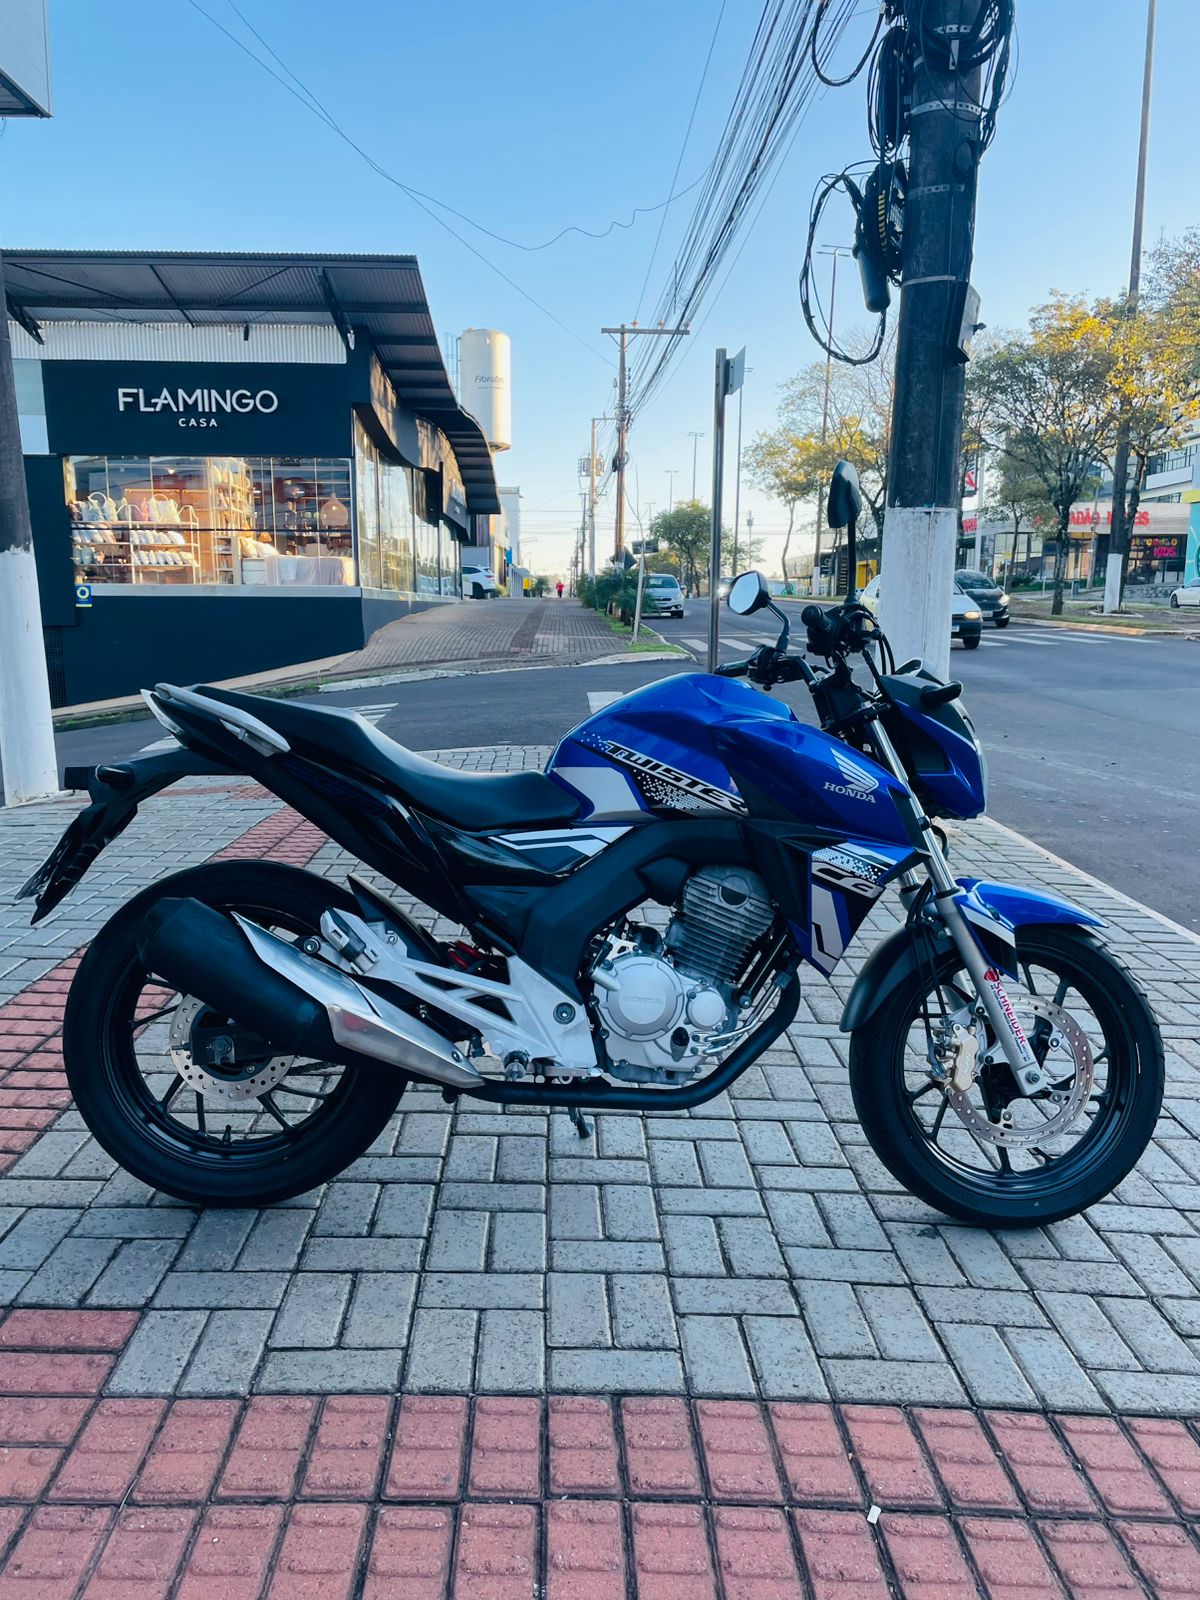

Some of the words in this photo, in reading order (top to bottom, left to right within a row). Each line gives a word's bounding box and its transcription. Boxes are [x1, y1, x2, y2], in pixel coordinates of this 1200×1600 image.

[117, 387, 279, 413] FLAMINGO
[178, 417, 218, 427] CASA
[1153, 547, 1177, 557] KIDS
[606, 742, 749, 816] TWISTER
[823, 782, 877, 804] HONDA
[812, 862, 886, 899] CB
[994, 981, 1026, 1044] SCHNEIDER
